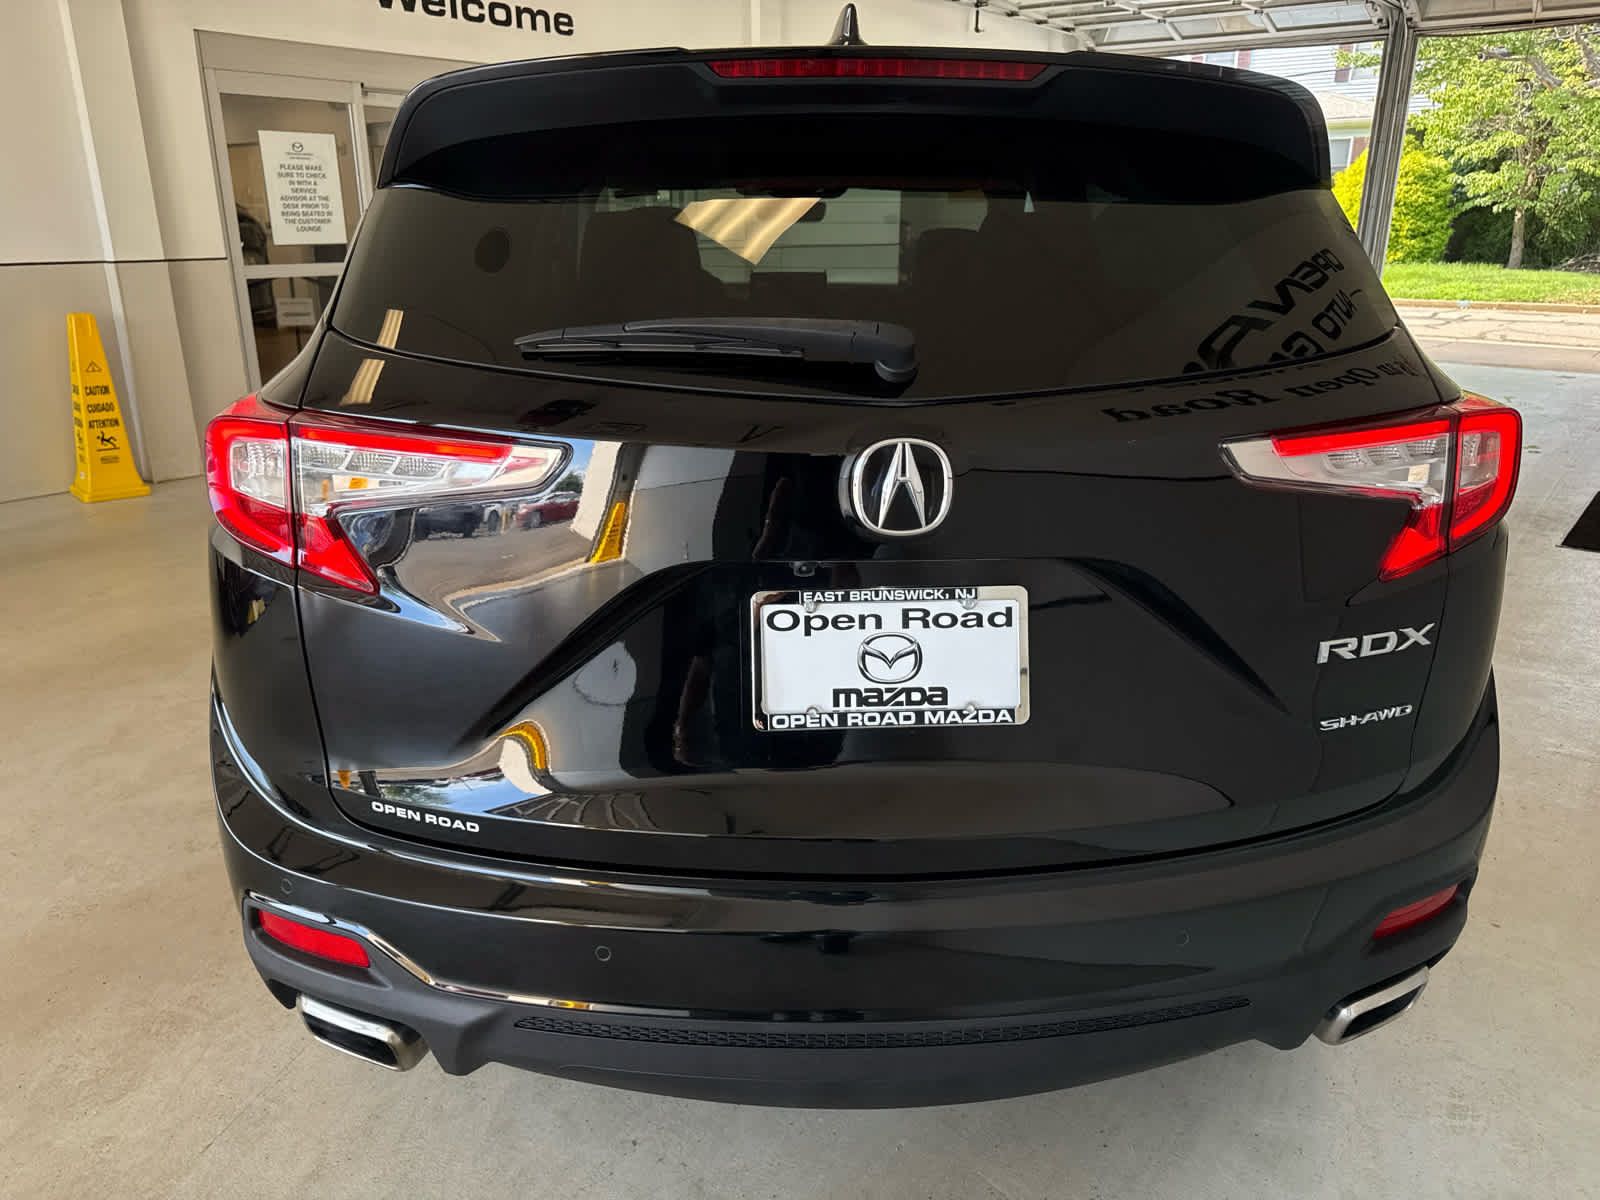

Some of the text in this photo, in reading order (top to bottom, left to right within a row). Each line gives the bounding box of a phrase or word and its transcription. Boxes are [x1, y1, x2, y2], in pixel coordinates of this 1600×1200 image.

[378, 0, 574, 36] elcome
[85, 385, 110, 396] CAUTION
[87, 402, 115, 413] CUIDADO
[803, 588, 976, 602] EAST BRUNSWICK, NJ
[766, 606, 1013, 637] Open Road
[1317, 623, 1435, 664] RDX
[772, 709, 1013, 729] OPEN ROAD MAZDA
[1320, 705, 1412, 731] SH-AWD
[371, 801, 480, 833] OPEN ROAD
